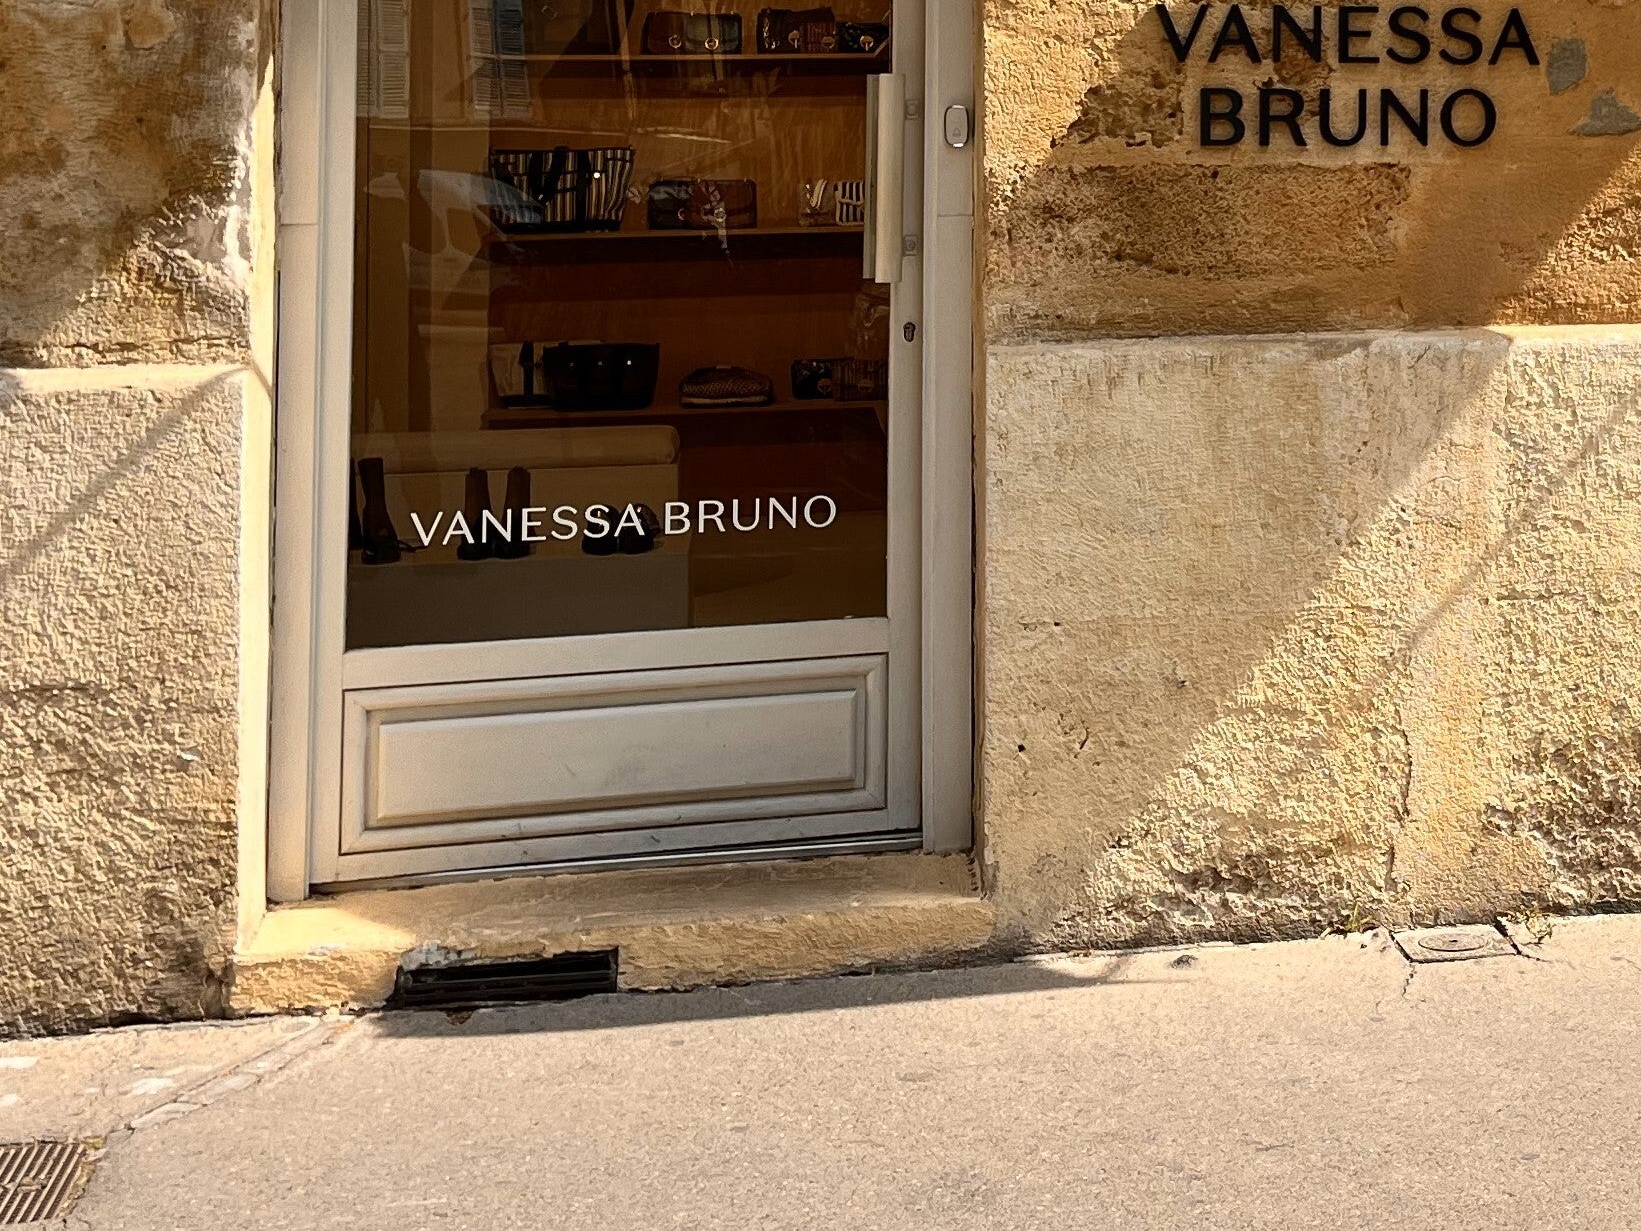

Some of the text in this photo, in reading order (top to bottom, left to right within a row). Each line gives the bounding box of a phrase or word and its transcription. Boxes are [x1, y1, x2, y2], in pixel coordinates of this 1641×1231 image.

[1155, 4, 1541, 66] VANESSA
[1199, 87, 1497, 148] BRUNO
[410, 494, 837, 547] VANESSA BRUNO
